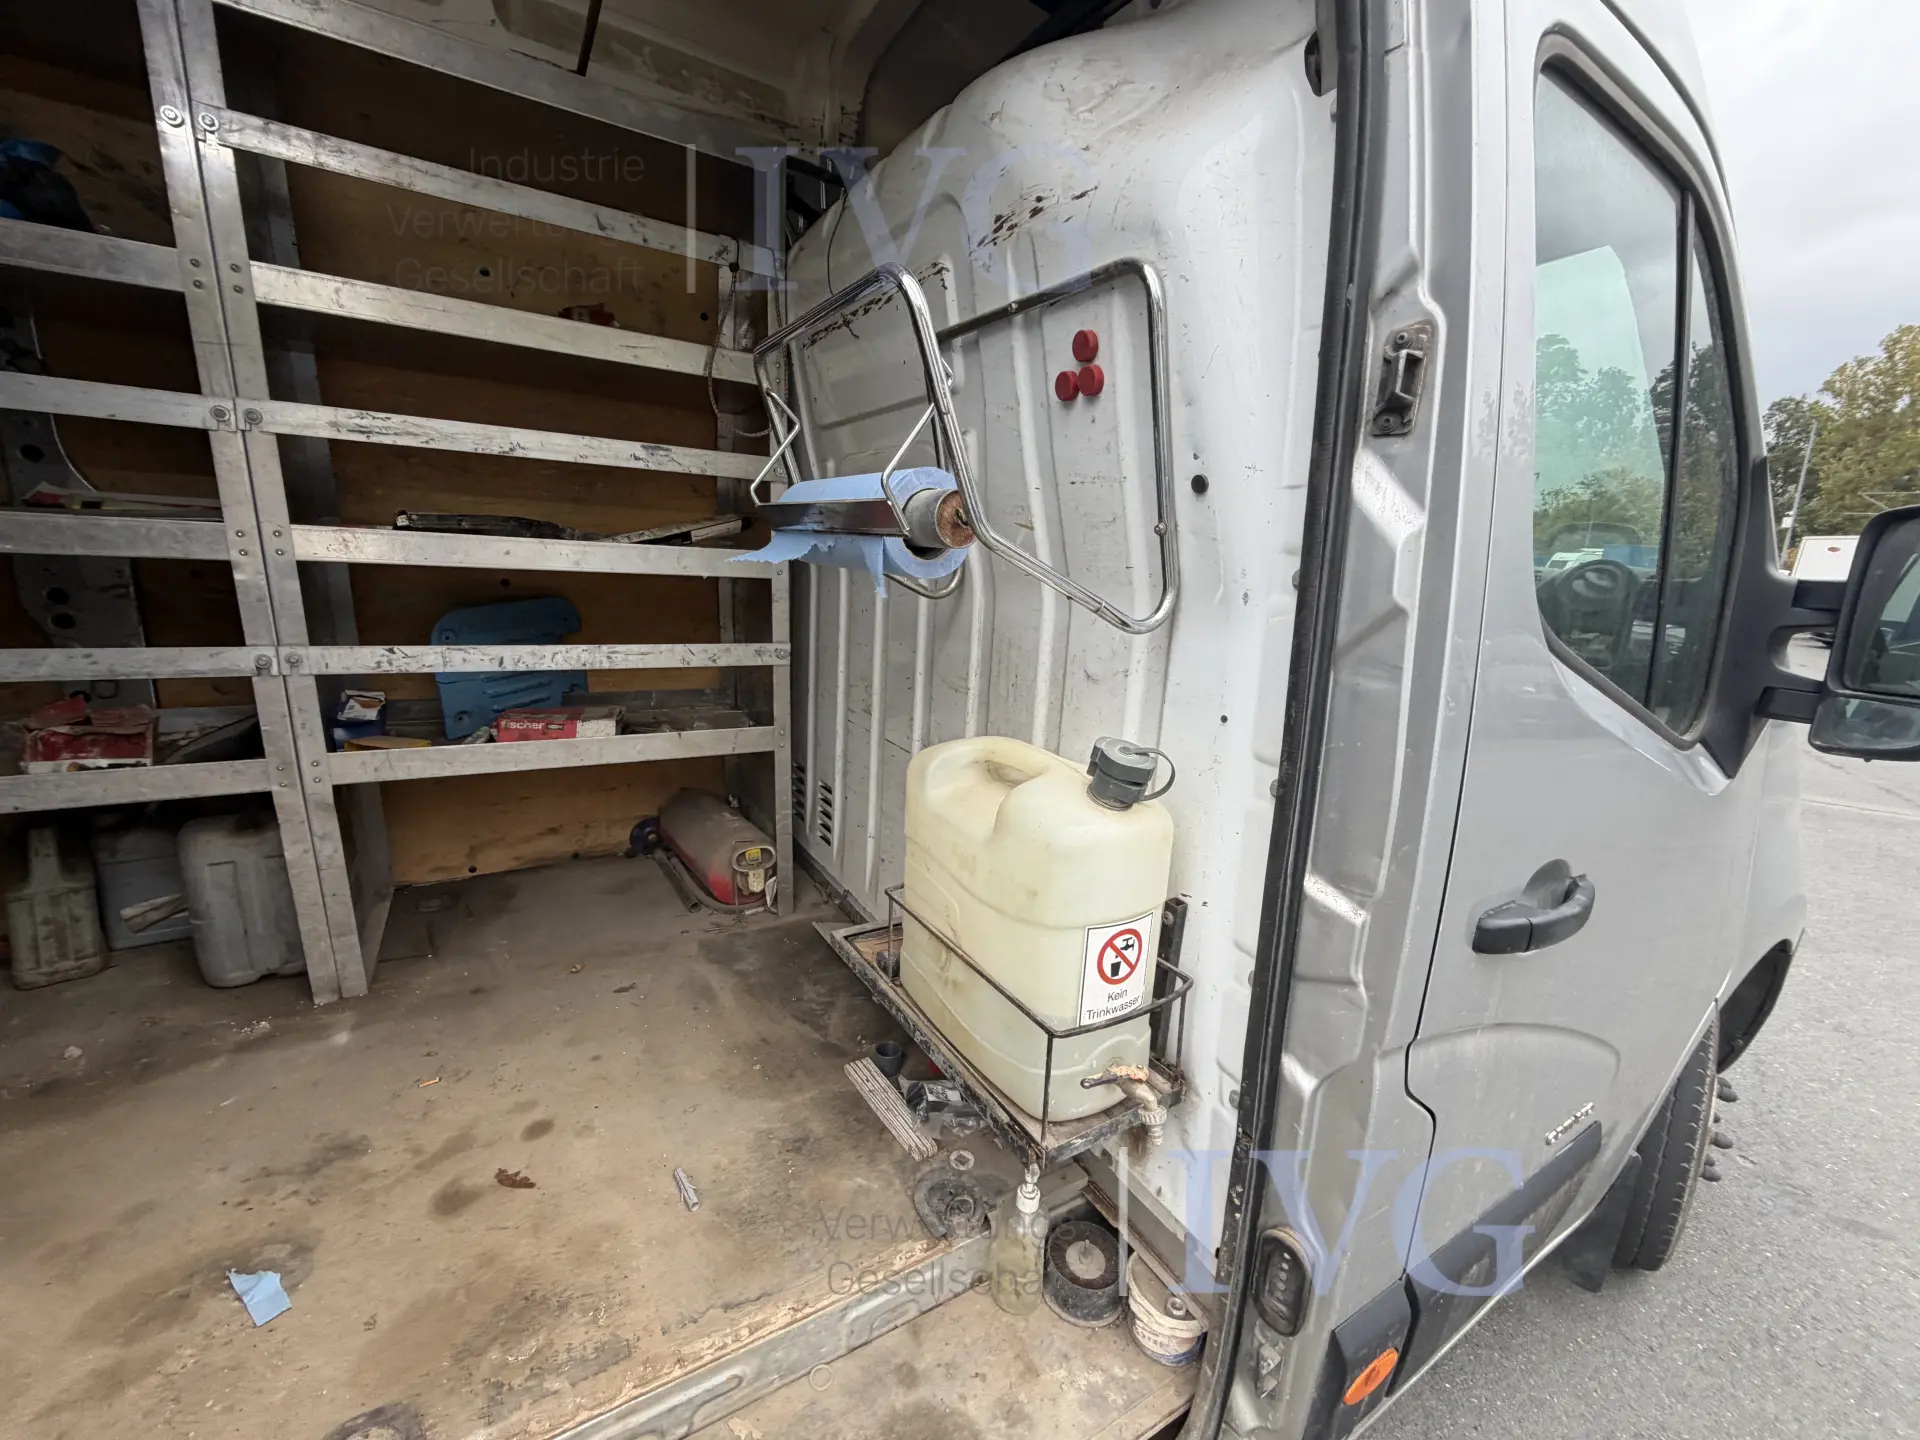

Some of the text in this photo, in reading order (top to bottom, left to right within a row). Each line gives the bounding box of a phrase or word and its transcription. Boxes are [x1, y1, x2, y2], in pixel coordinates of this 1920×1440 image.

[500, 719, 545, 730] fischer
[1107, 988, 1128, 1003] Kein
[1086, 995, 1140, 1020] Trinkwasser
